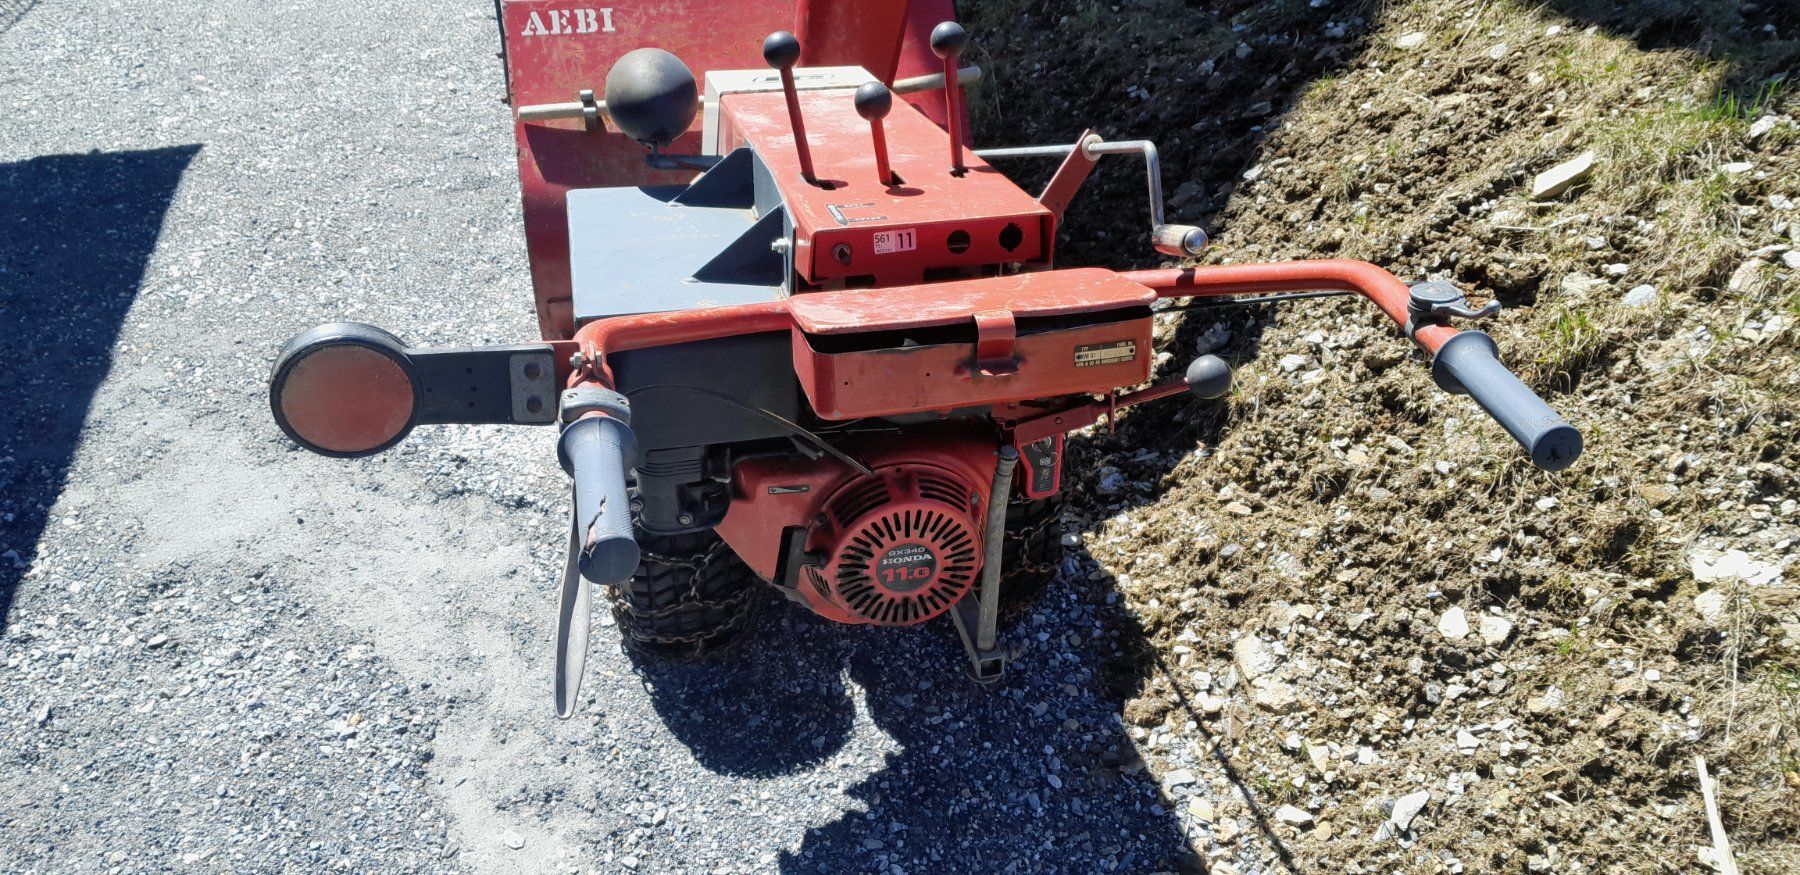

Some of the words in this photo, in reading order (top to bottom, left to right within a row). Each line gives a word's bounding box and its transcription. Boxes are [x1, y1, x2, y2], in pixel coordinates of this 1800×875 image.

[521, 8, 616, 36] AEBI
[875, 234, 890, 243] 561
[898, 232, 912, 249] 11
[888, 547, 926, 556] GX340
[883, 554, 933, 565] HONDA
[882, 566, 930, 582] 11.0
